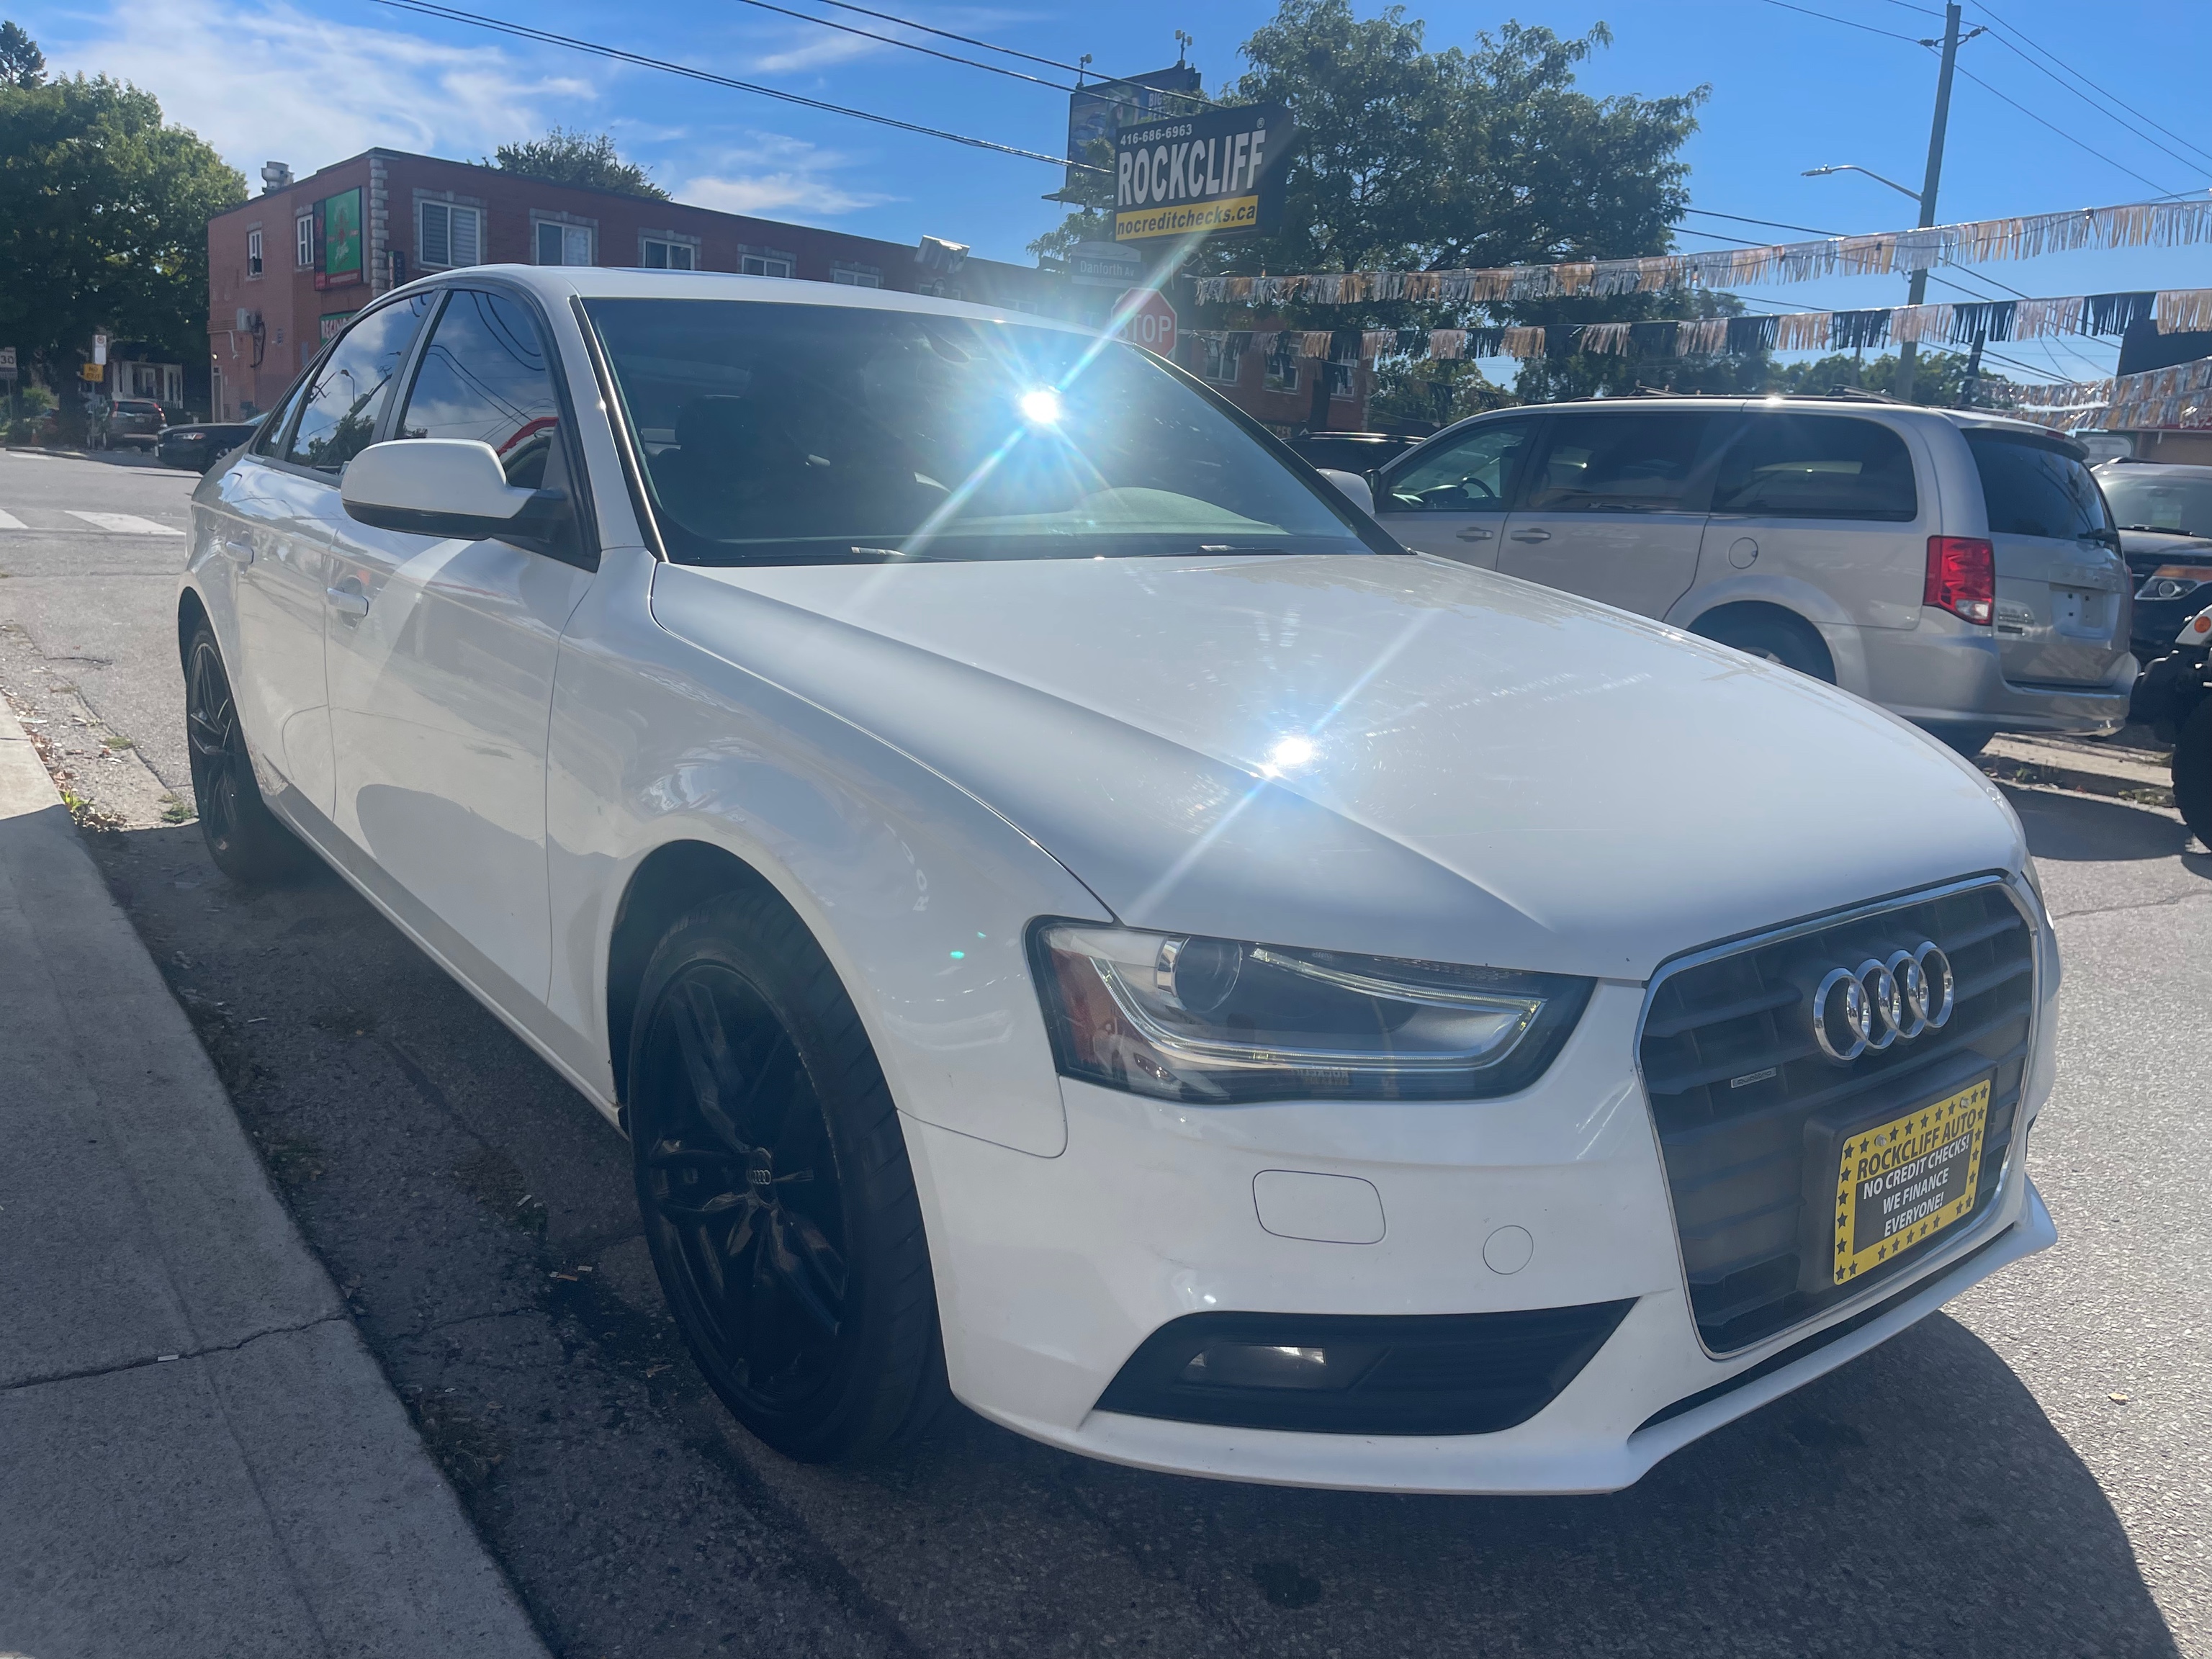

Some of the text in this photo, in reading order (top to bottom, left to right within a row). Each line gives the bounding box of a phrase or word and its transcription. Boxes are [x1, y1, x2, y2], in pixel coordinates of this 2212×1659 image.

[1120, 124, 1192, 146] 416-686-6963
[1118, 129, 1267, 207] ROCKCLIFF
[1118, 205, 1255, 235] nocreditchecks.ca
[1080, 260, 1135, 276] Danforth Av
[1857, 1108, 1977, 1181] ROCKCLIFF AUTO
[1863, 1133, 1970, 1200] NO CREDIT CHECKS!
[1883, 1167, 1949, 1215] WE FINANCE
[1884, 1192, 1944, 1237] EVERYONE!
